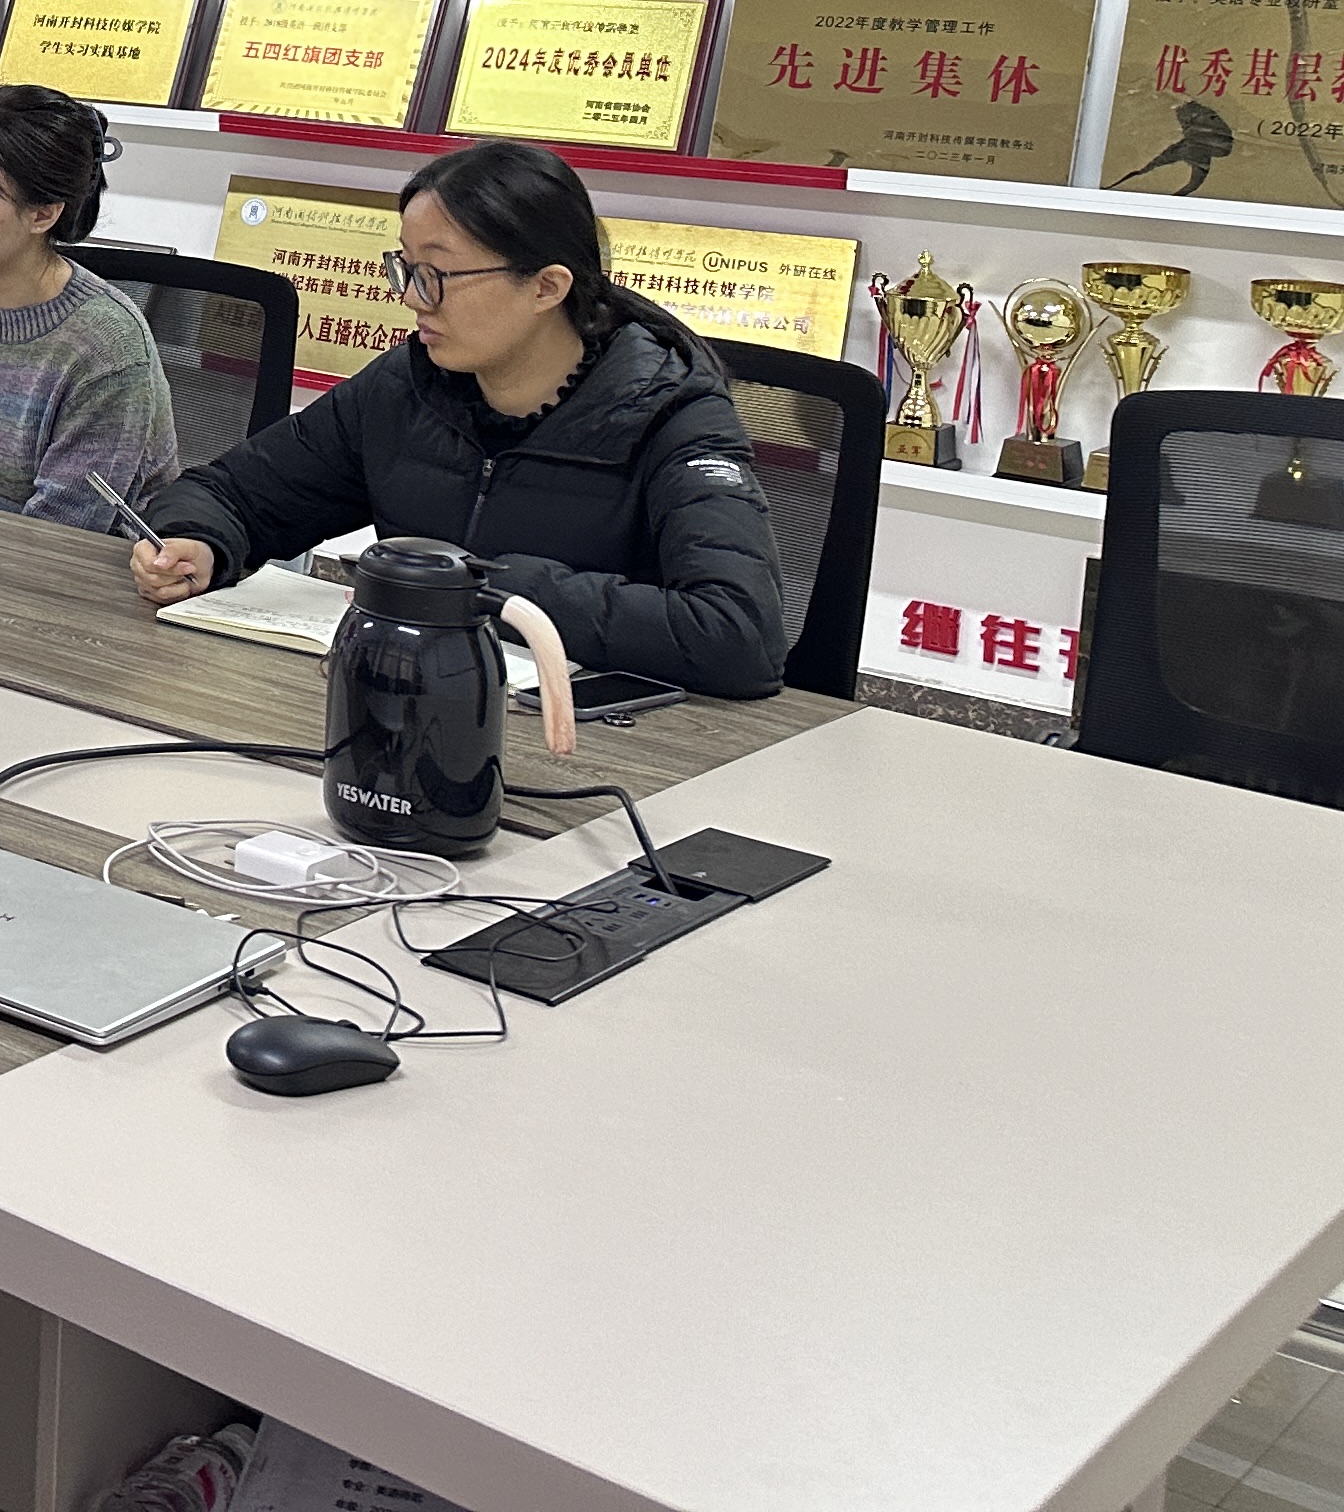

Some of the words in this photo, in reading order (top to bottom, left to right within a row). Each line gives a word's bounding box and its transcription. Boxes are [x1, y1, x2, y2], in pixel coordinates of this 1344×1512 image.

[32, 14, 162, 35] 河南开封科技传媒学院
[815, 15, 996, 36] 2022年度教学管理工作
[39, 40, 142, 60] 学生实习实践基地
[242, 41, 385, 69] 五四红旗团支部
[481, 46, 673, 82] 2024年度优秀会员单位
[766, 43, 1041, 105] 先进集体
[703, 251, 769, 273] UNIPUS
[778, 263, 838, 282] 外研在线
[336, 782, 412, 816] YESWATER
